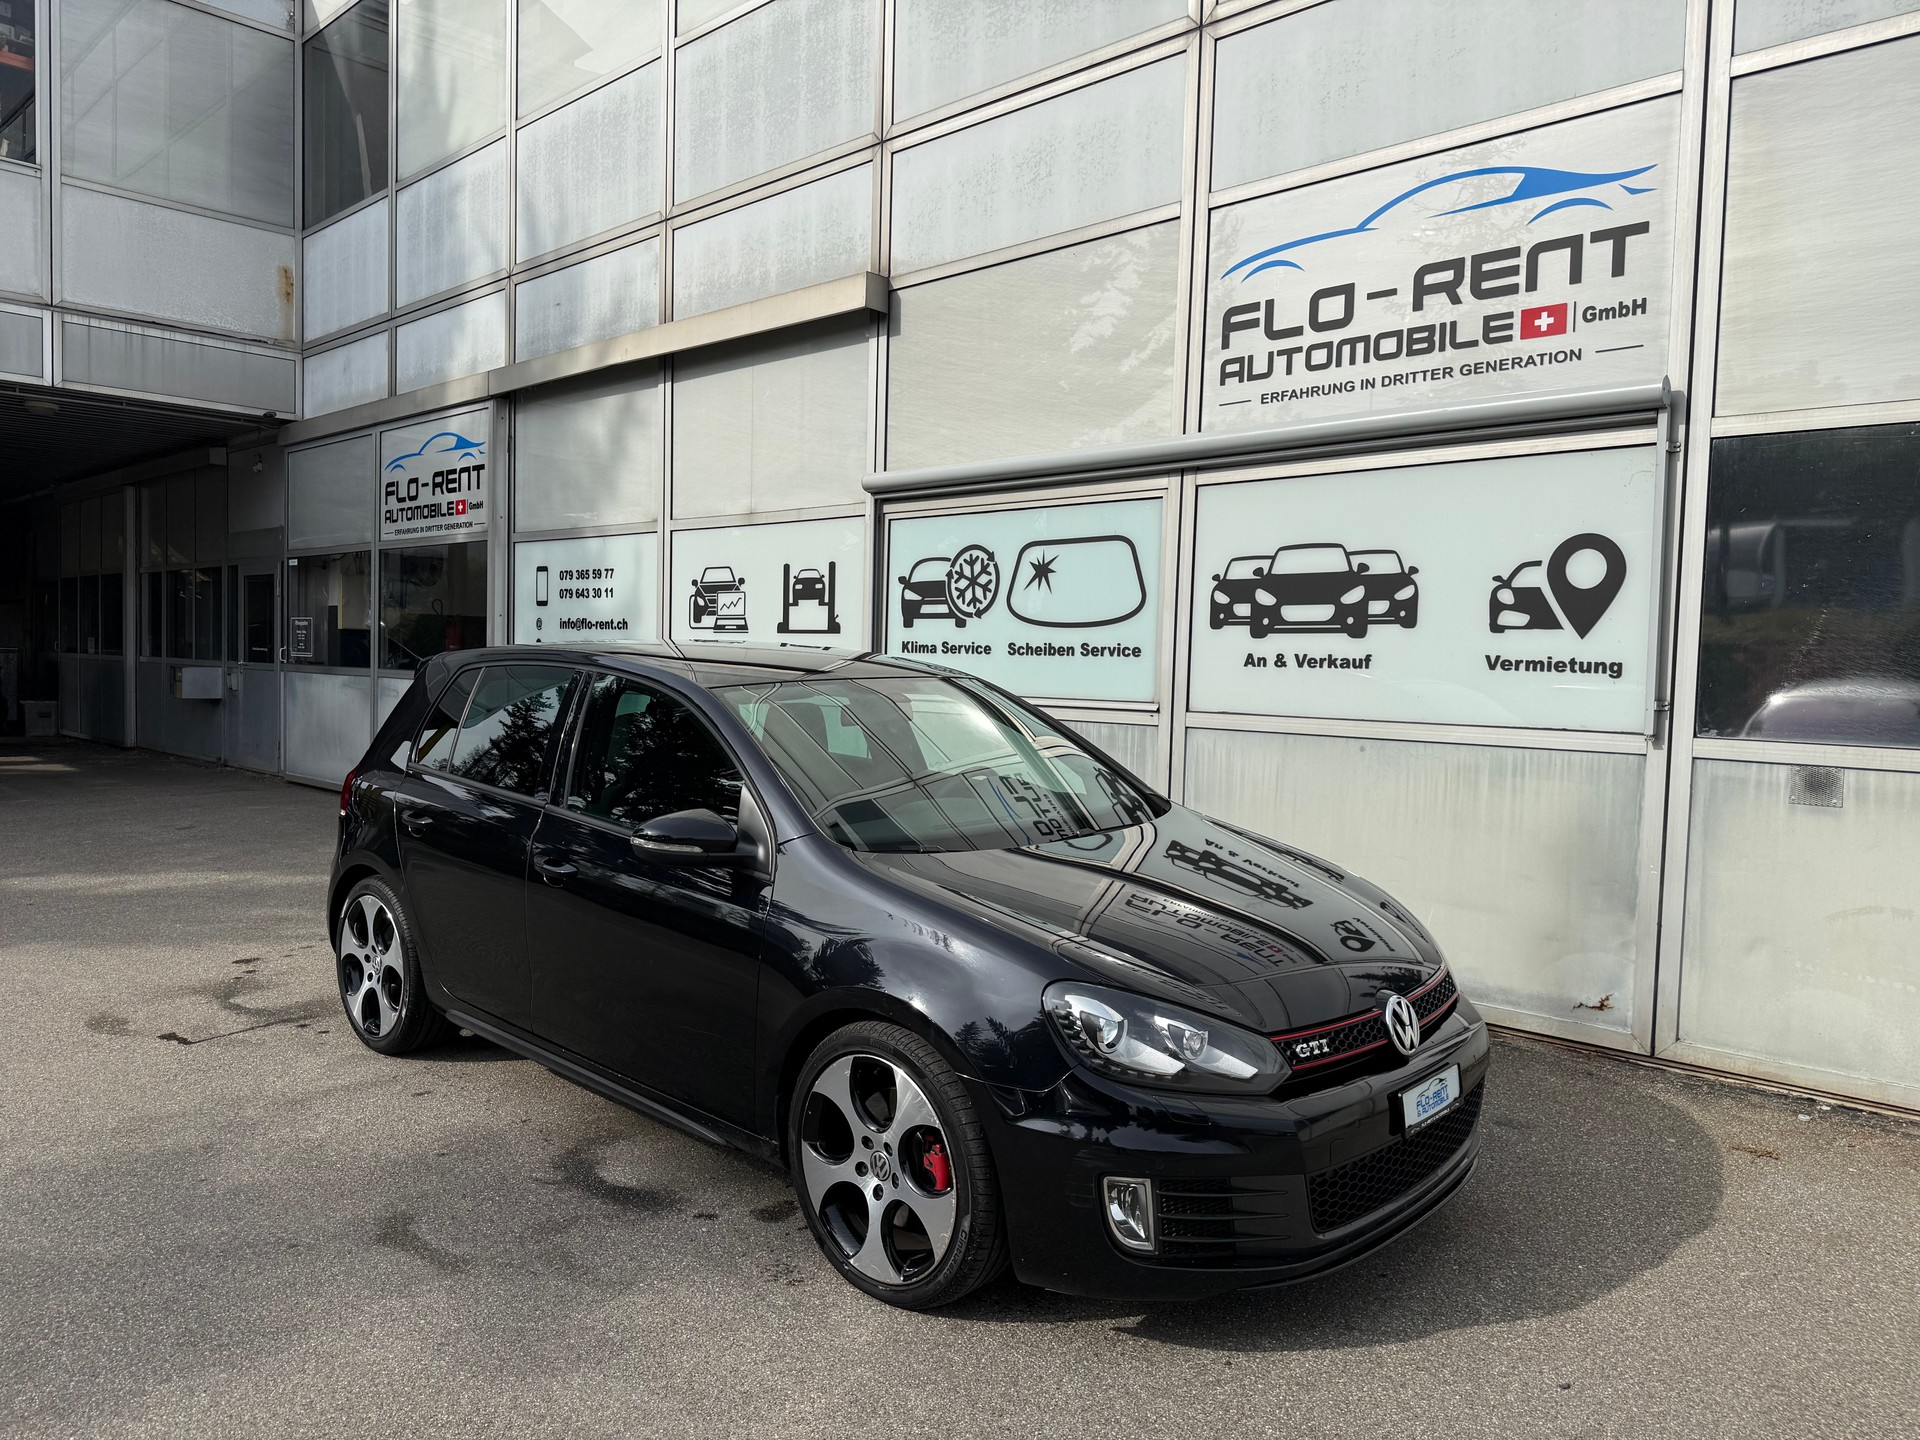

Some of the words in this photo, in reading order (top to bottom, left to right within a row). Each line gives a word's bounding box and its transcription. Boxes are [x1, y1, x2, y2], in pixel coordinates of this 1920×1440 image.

[1220, 220, 1650, 350] FLO-RENT
[1219, 310, 1514, 387] AUTOMOBILE
[1581, 298, 1648, 324] GmbH
[1260, 379, 1355, 405] ERFAHRUNG
[1360, 377, 1376, 391] IN
[1381, 366, 1454, 387] DRITTER
[1459, 348, 1582, 377] GENERATION
[385, 463, 486, 505] FLO-RENT
[384, 501, 455, 524] AUTOMOBILE
[468, 501, 484, 511] GmbH
[394, 526, 419, 536] ERFAHRUNG
[420, 525, 424, 533] IN
[425, 524, 443, 533] DRITTER
[444, 521, 473, 531] GENERATION
[559, 570, 573, 581] 079
[575, 569, 590, 580] 365
[592, 568, 602, 579] 59
[604, 568, 614, 579] 77
[559, 588, 573, 599] 079
[575, 588, 590, 599] 643
[592, 588, 602, 599] 30
[604, 587, 614, 598] 11
[559, 618, 628, 631] info@flo-rent.ch
[901, 640, 937, 655] Klima
[941, 641, 992, 656] Service
[1007, 642, 1075, 657] Scheiben
[1080, 643, 1142, 658] Service
[1243, 653, 1268, 669] An
[1274, 654, 1288, 669] &
[1295, 653, 1372, 670] Verkauf
[1485, 655, 1623, 679] Vermietung
[1295, 1039, 1330, 1058] GTI
